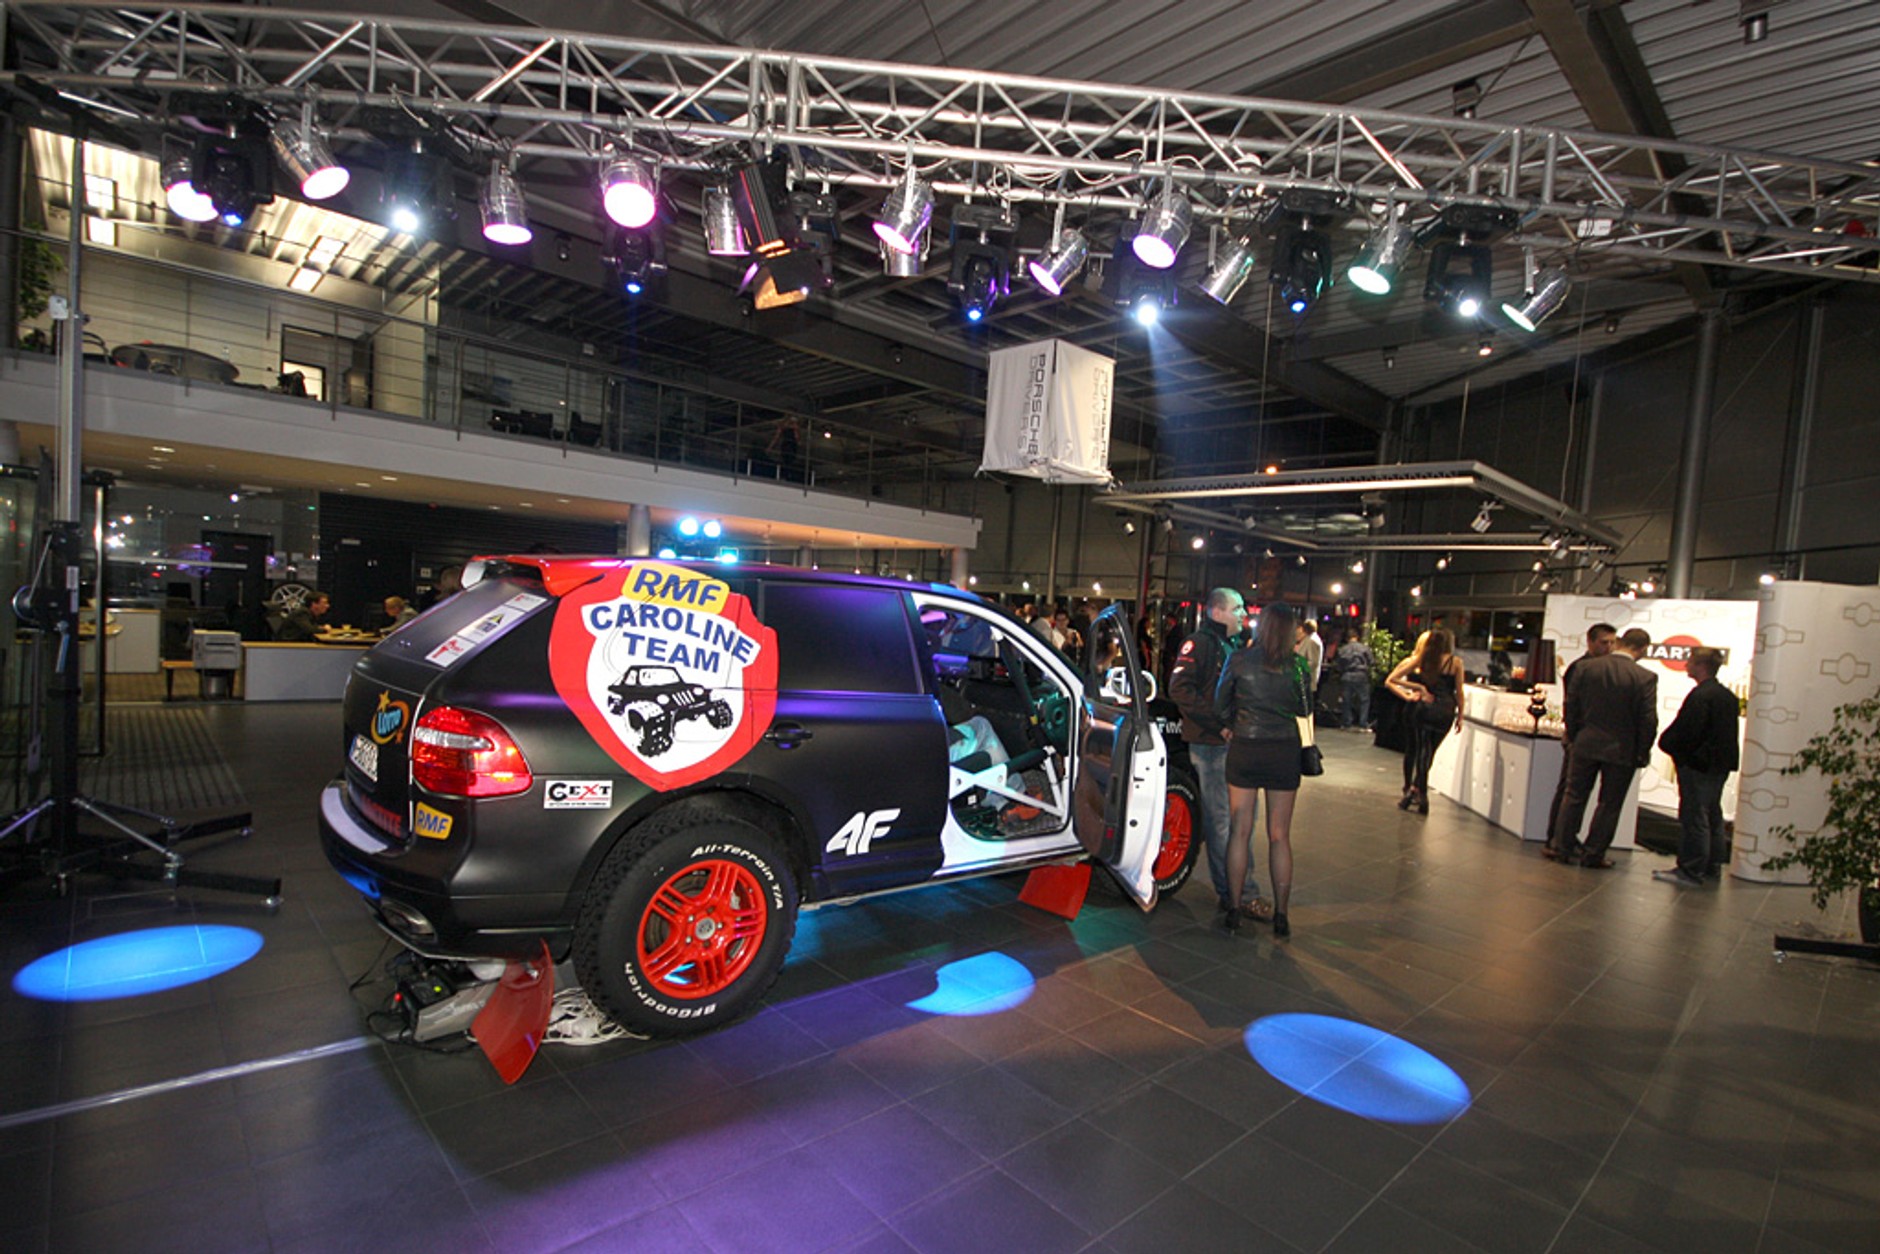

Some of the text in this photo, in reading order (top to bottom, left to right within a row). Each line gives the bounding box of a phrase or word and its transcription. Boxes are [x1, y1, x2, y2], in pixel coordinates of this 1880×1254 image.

[1027, 353, 1046, 456] PORSCHE
[633, 568, 722, 608] RMF
[590, 603, 754, 664] CAROLINE
[623, 632, 721, 673] TEAM
[417, 809, 450, 834] RMF
[825, 808, 901, 856] 4F
[690, 843, 784, 910] All-Terrain T/A
[624, 961, 718, 1019] BFGoodrich
